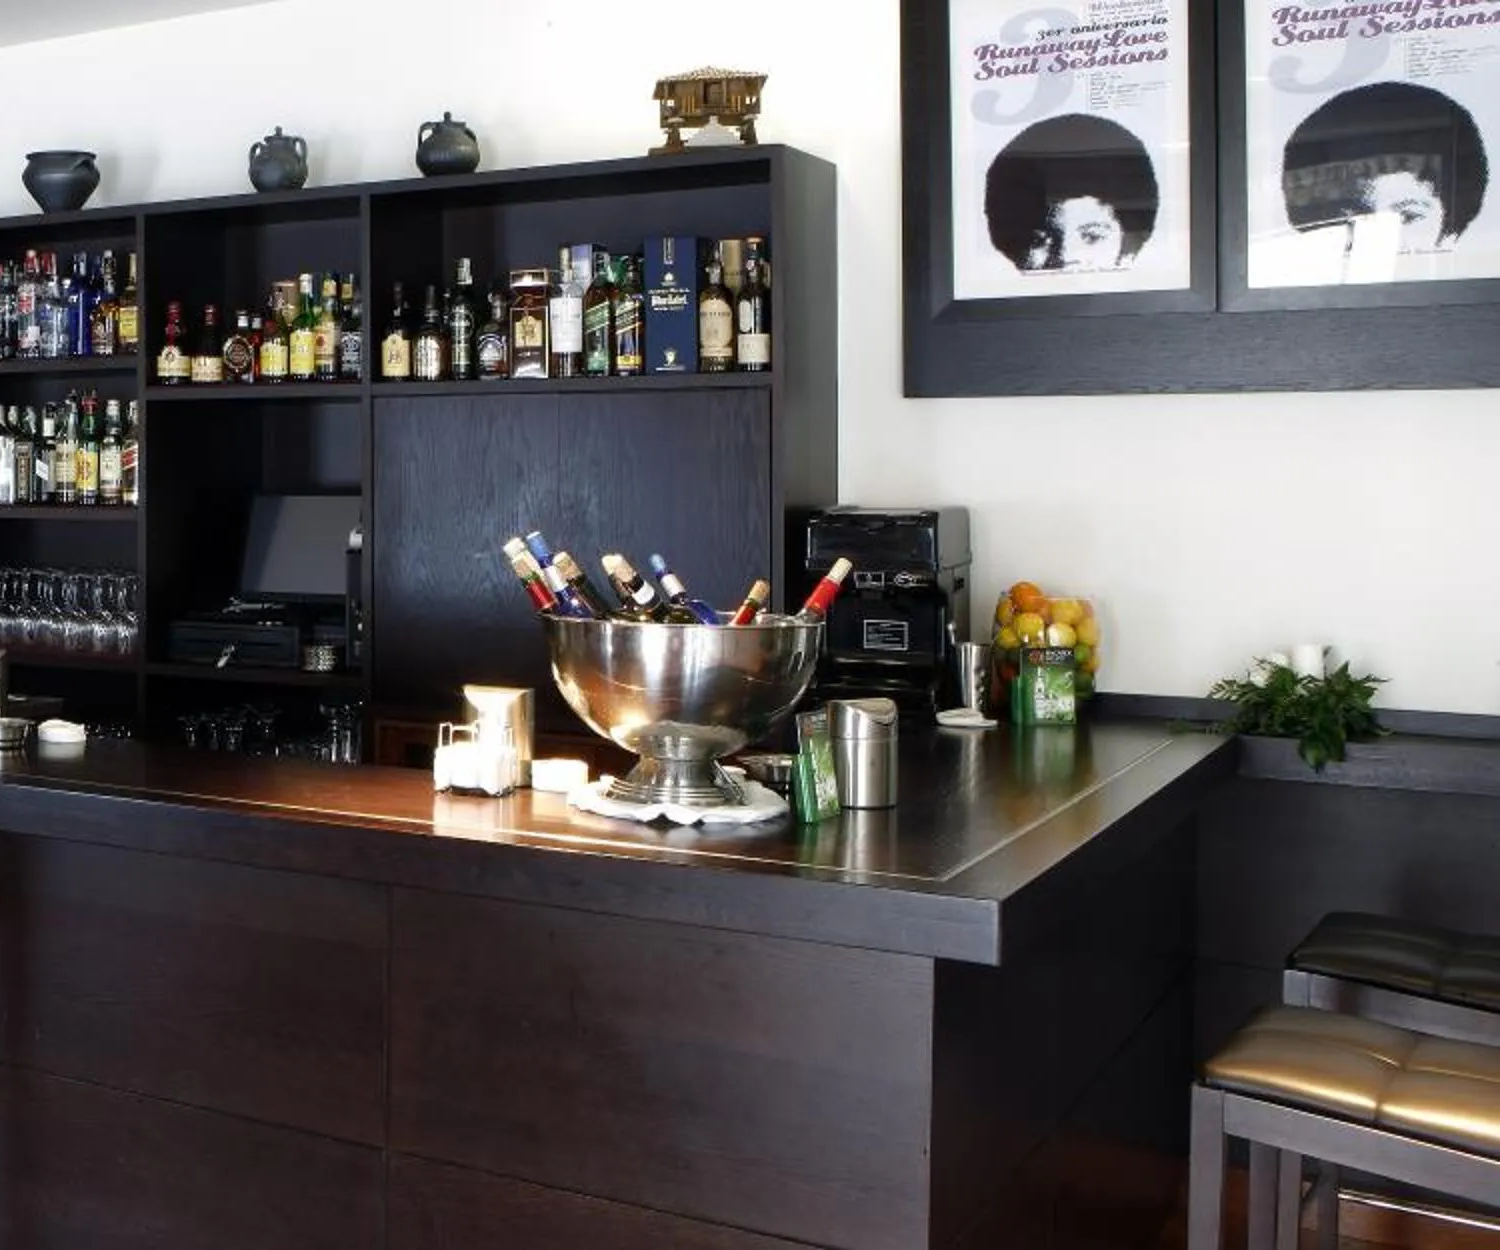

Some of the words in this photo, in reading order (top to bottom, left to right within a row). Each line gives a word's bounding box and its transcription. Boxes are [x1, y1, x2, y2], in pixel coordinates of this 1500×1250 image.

[1070, 15, 1168, 35] aniversario
[1272, 19, 1349, 46] Soul
[973, 58, 1040, 81] Soul
[1047, 47, 1169, 73] Sessions
